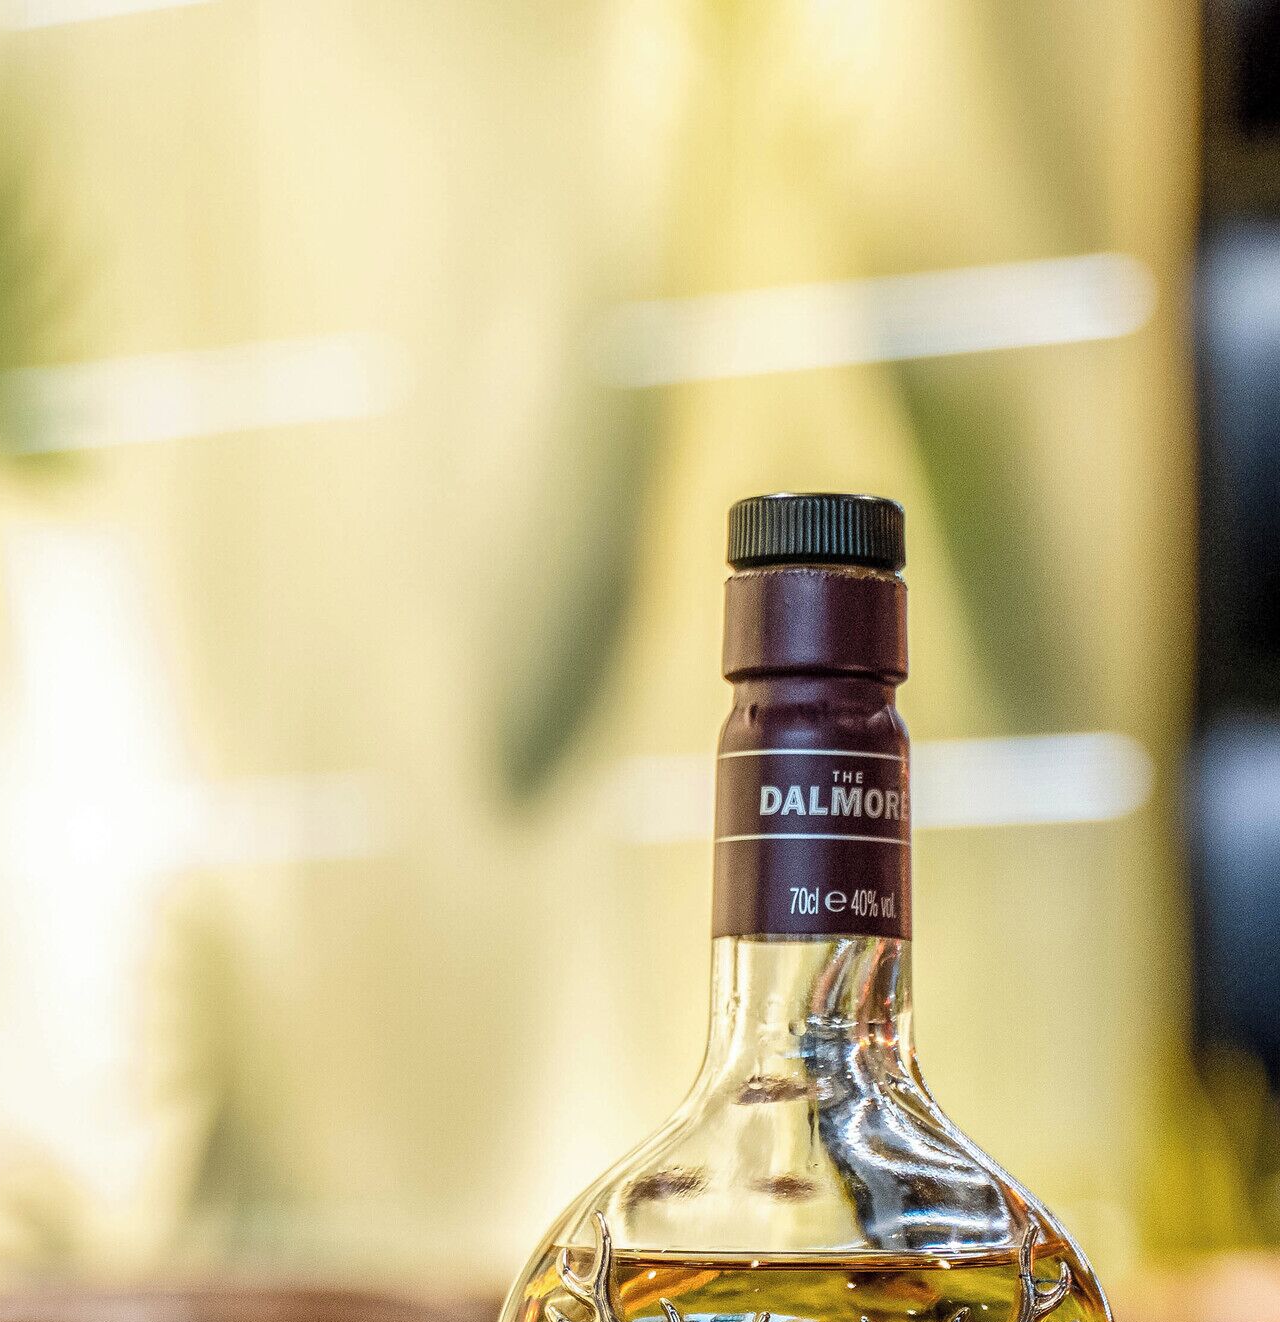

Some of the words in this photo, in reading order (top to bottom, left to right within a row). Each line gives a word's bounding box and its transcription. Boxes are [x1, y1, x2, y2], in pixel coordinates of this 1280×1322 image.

[832, 770, 864, 784] THE
[789, 887, 819, 914] 70cl
[851, 889, 878, 917] 40%
